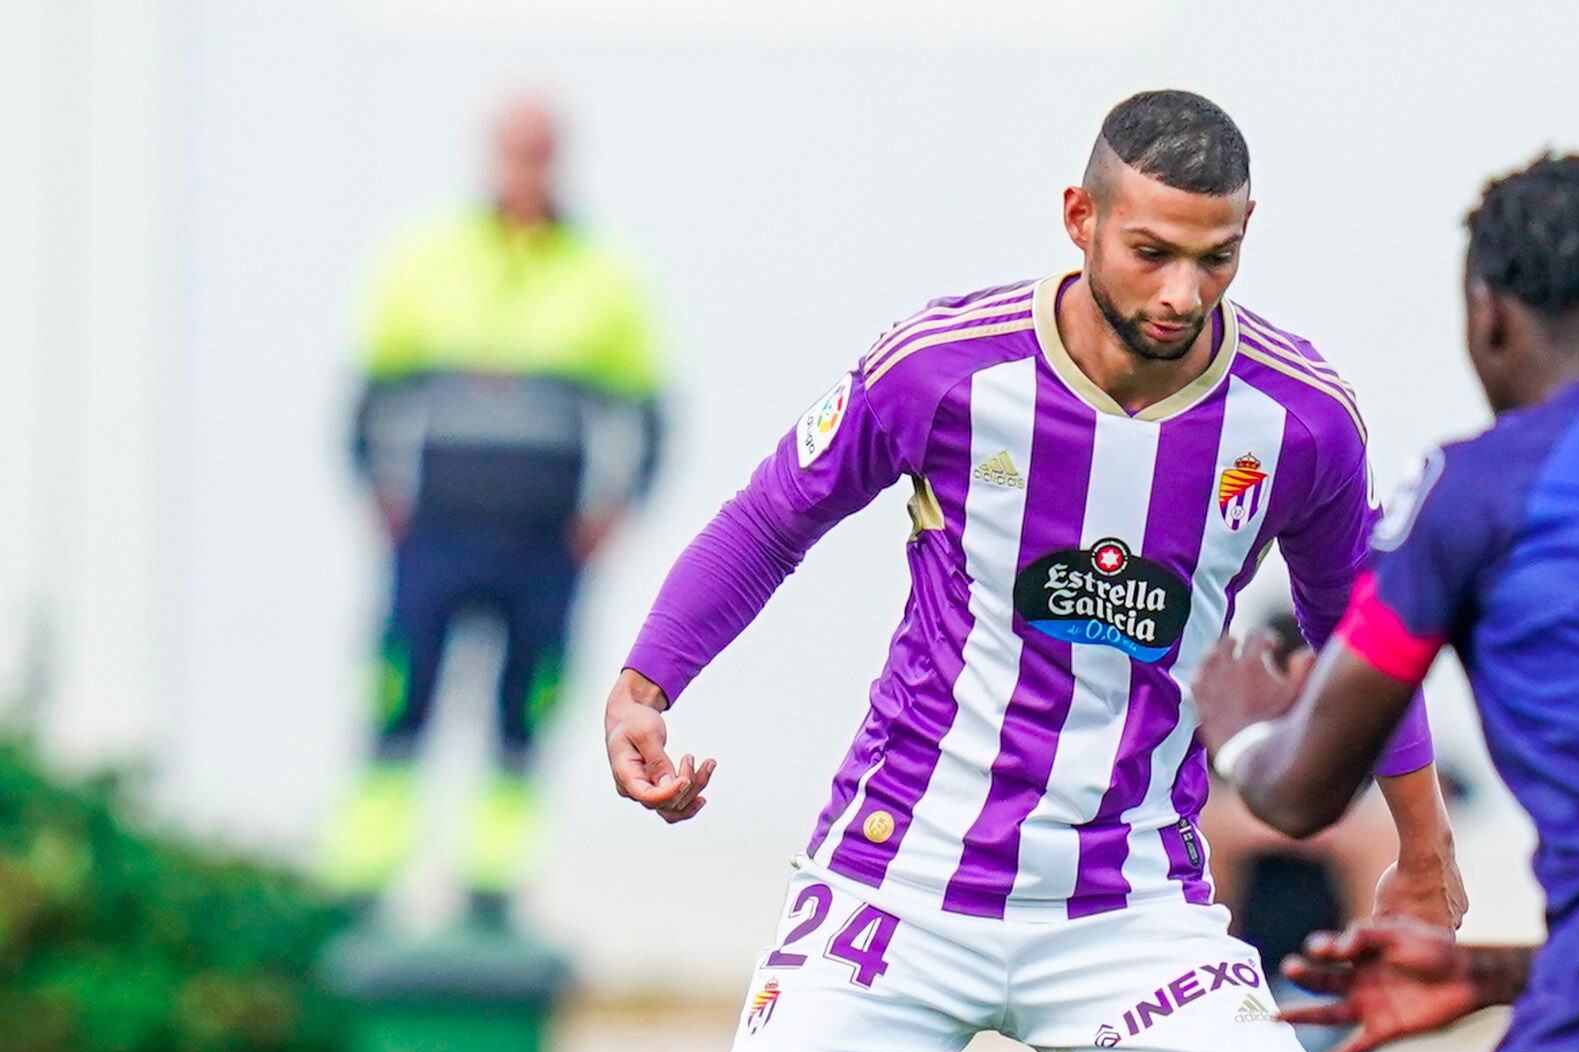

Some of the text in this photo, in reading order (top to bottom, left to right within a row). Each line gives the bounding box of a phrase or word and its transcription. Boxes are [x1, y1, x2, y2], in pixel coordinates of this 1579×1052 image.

[1044, 563, 1167, 611] Estrella
[1048, 589, 1155, 642] Galicia
[760, 883, 901, 988] 24
[1123, 962, 1260, 1036] INEXO
